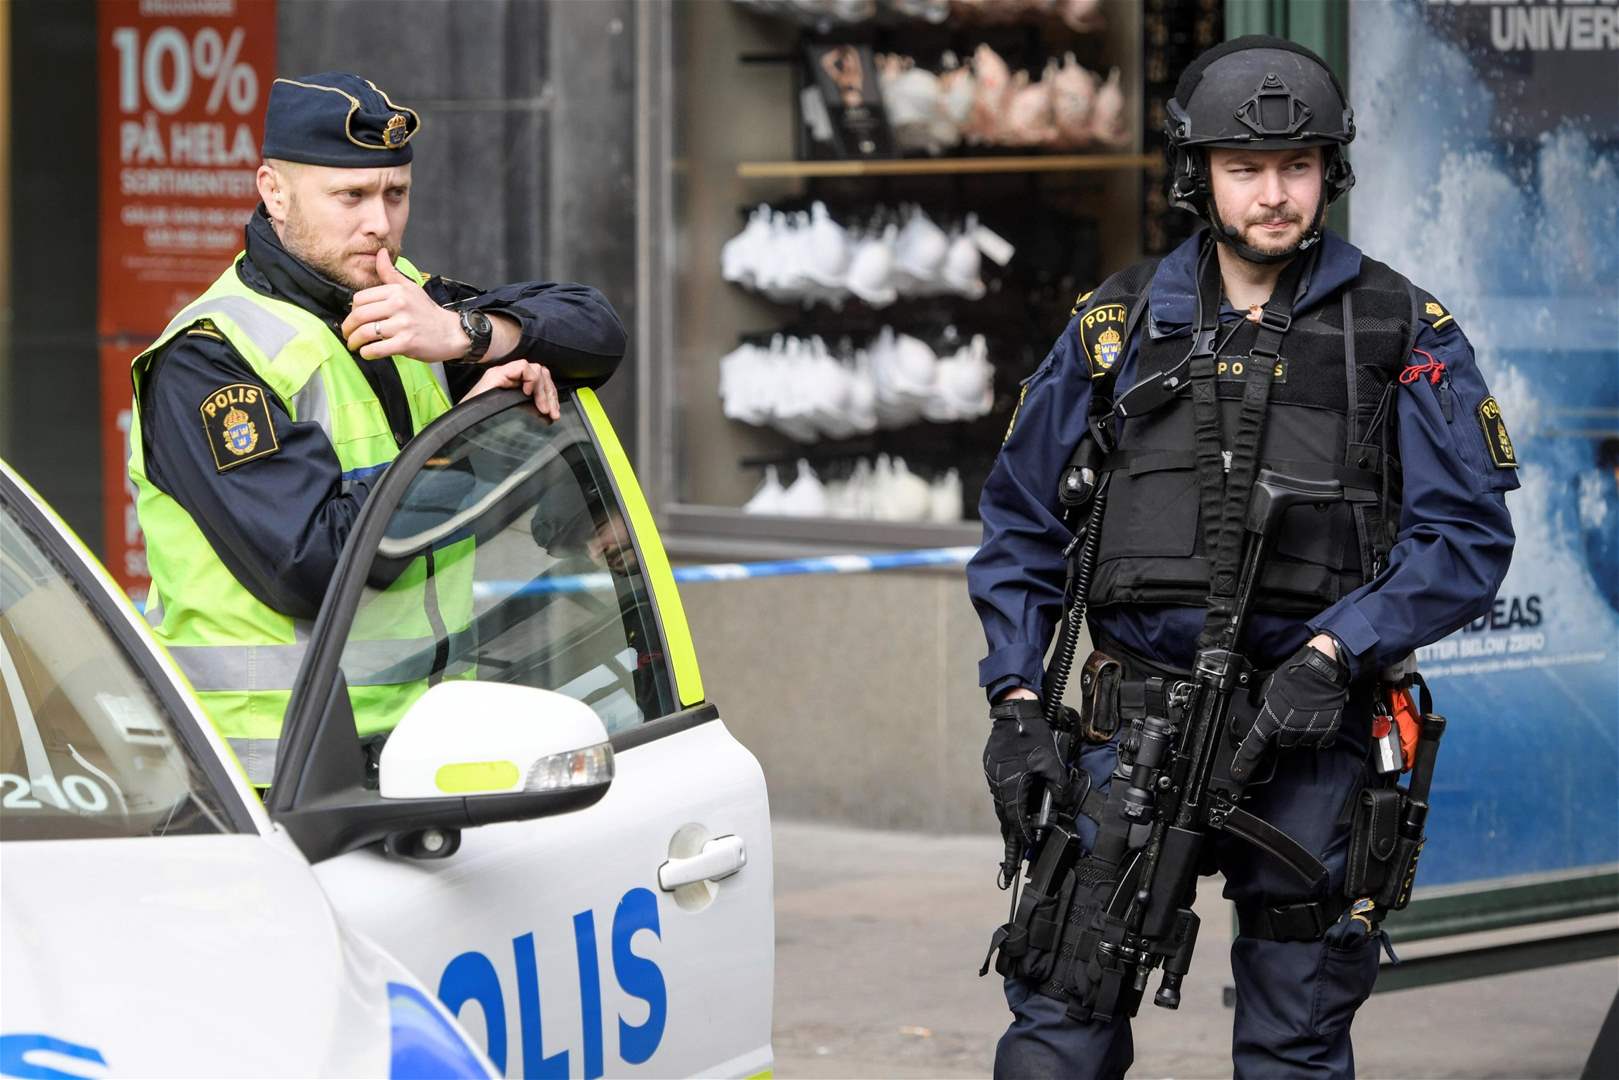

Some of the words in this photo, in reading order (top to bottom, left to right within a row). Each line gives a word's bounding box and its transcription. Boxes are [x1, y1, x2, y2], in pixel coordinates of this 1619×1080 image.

[1490, 6, 1619, 50] UNIVER
[112, 26, 259, 114] 10%
[120, 112, 165, 164] PÅ
[169, 122, 258, 165] HELA
[1216, 361, 1284, 377] POS
[204, 387, 258, 418] POLIS
[1462, 595, 1543, 633] EAS
[1459, 636, 1507, 658] BELOW
[1508, 631, 1545, 654] ZERO
[0, 773, 108, 811] 210
[437, 886, 667, 1080] OLIS
